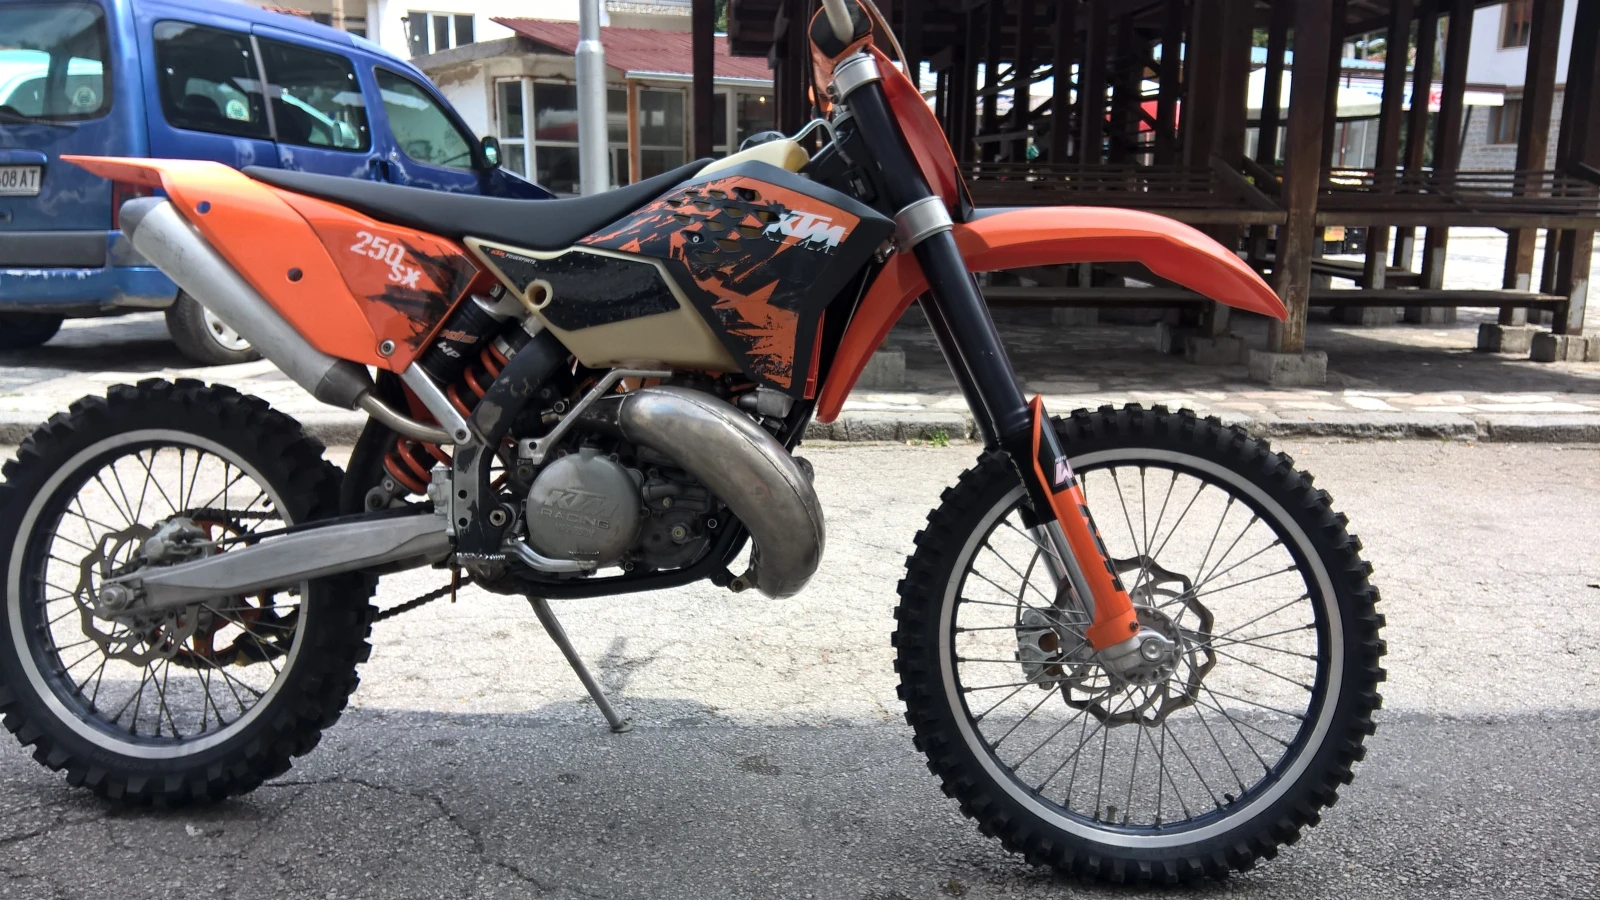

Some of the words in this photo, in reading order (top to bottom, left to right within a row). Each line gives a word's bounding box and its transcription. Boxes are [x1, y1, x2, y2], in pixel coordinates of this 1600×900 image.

[0, 170, 17, 187] 08
[19, 169, 38, 187] AT
[762, 210, 846, 250] KTM
[350, 231, 405, 266] 250
[437, 341, 461, 358] WP
[544, 487, 619, 518] KTM
[540, 508, 609, 529] RACING
